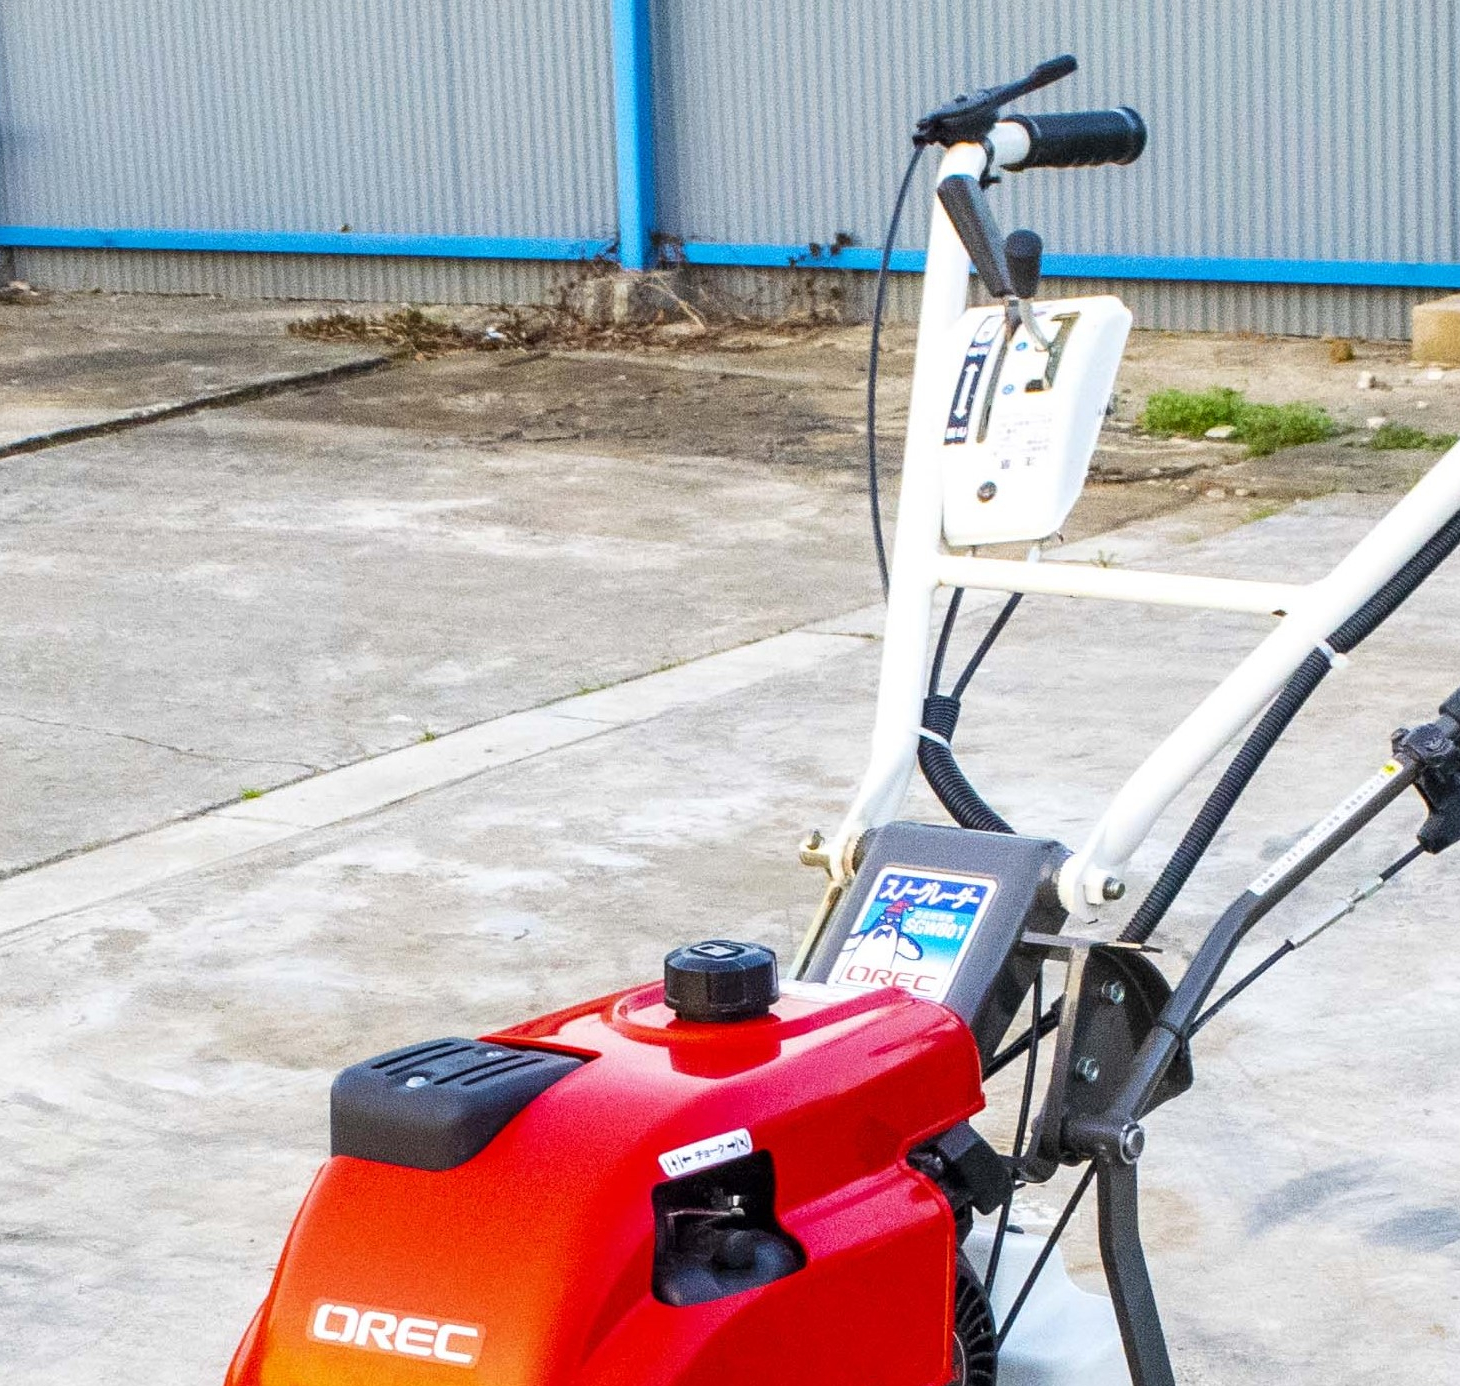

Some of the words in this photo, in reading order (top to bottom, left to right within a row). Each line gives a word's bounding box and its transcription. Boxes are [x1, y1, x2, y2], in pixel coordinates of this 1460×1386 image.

[879, 879, 980, 909] スノーグレーダー
[846, 966, 937, 991] OREC
[695, 1144, 724, 1160] チョーク
[313, 1303, 478, 1364] OREC
